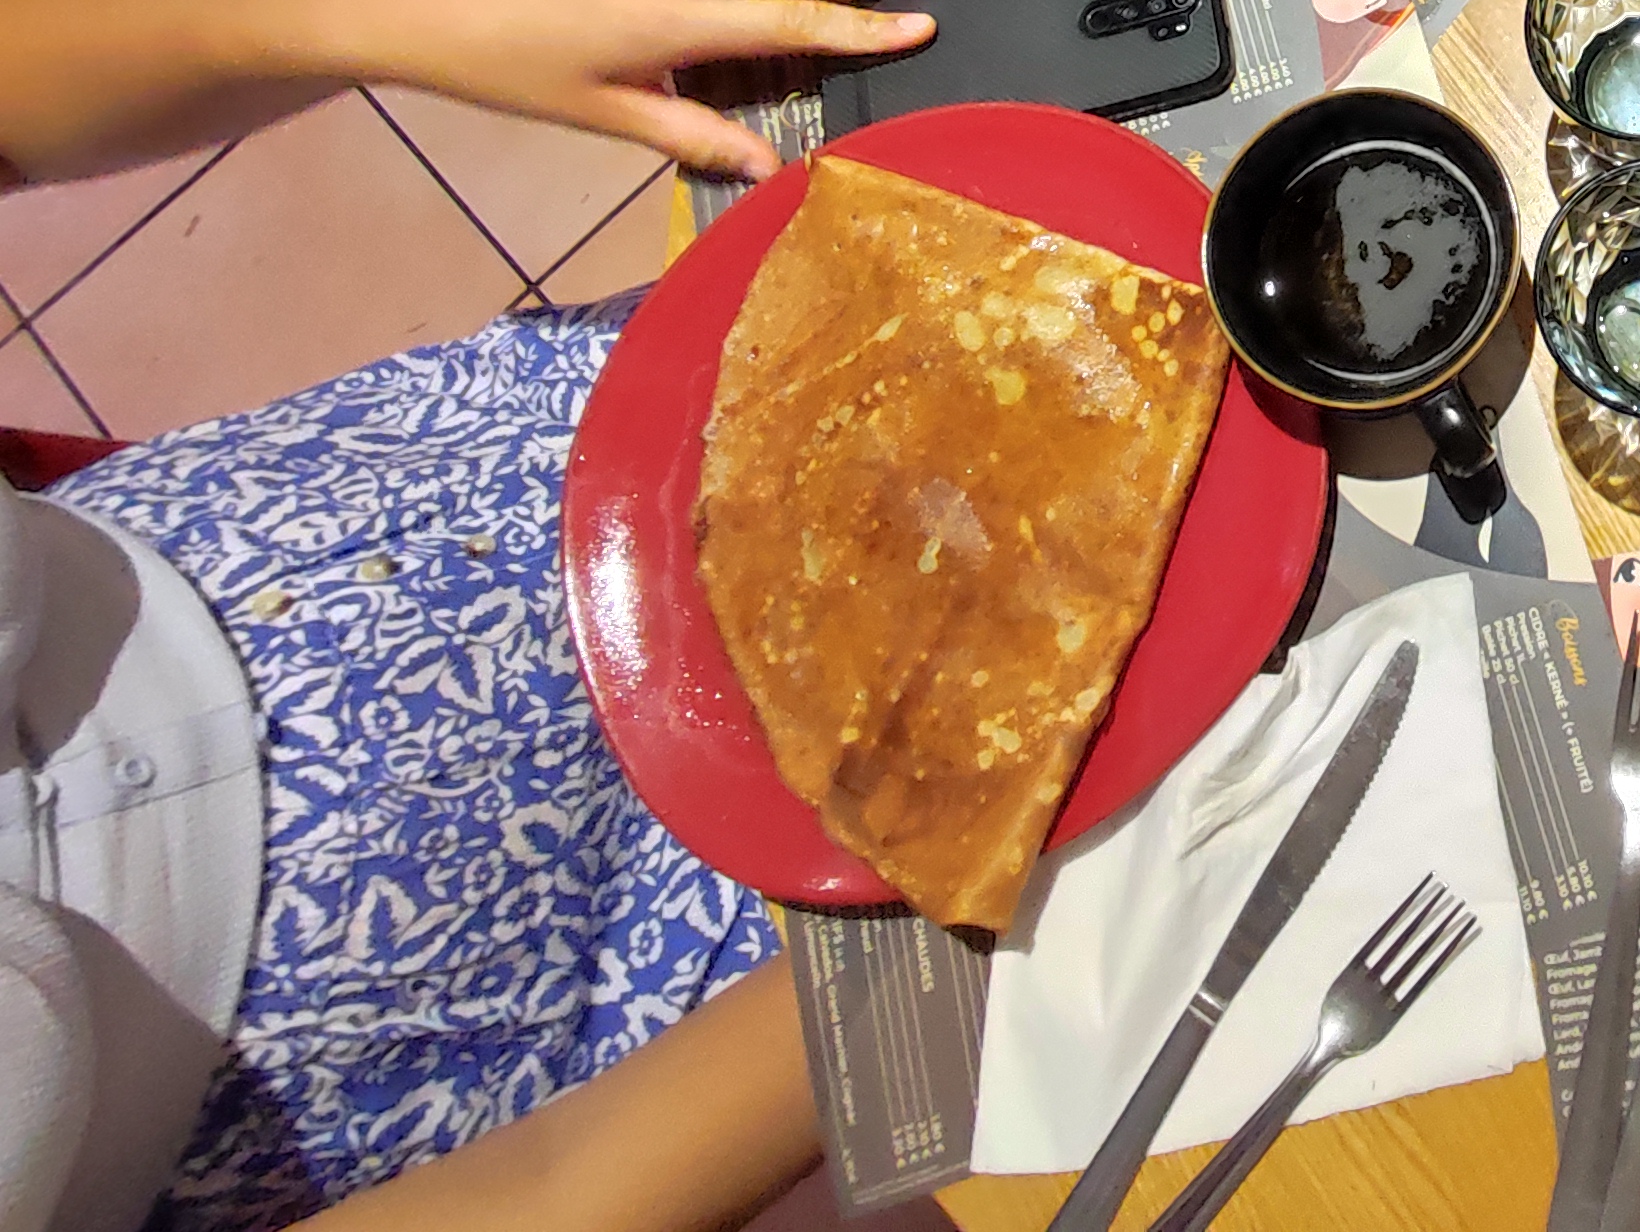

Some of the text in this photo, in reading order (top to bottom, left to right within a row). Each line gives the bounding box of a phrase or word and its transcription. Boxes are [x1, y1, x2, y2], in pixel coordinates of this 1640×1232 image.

[1236, 70, 1250, 92] 4.00
[1248, 67, 1261, 88] 4.00
[1258, 64, 1271, 85] 4.00
[1268, 60, 1281, 81] 4.00
[1504, 615, 1522, 653] Pichet
[1516, 611, 1536, 660] Pression
[1493, 619, 1520, 686] Pichet 50 cl
[1556, 617, 1587, 686] Boissons
[1495, 673, 1507, 686] cl
[1528, 606, 1549, 652] CIDRE
[1544, 661, 1570, 710] KERNÉ
[1566, 736, 1594, 794] FRUITÉ)
[1562, 898, 1573, 911] €
[1574, 894, 1586, 906] €
[1586, 890, 1598, 902] €
[1526, 913, 1537, 925] €
[1538, 908, 1549, 920] €
[912, 917, 935, 993] CHAUDES
